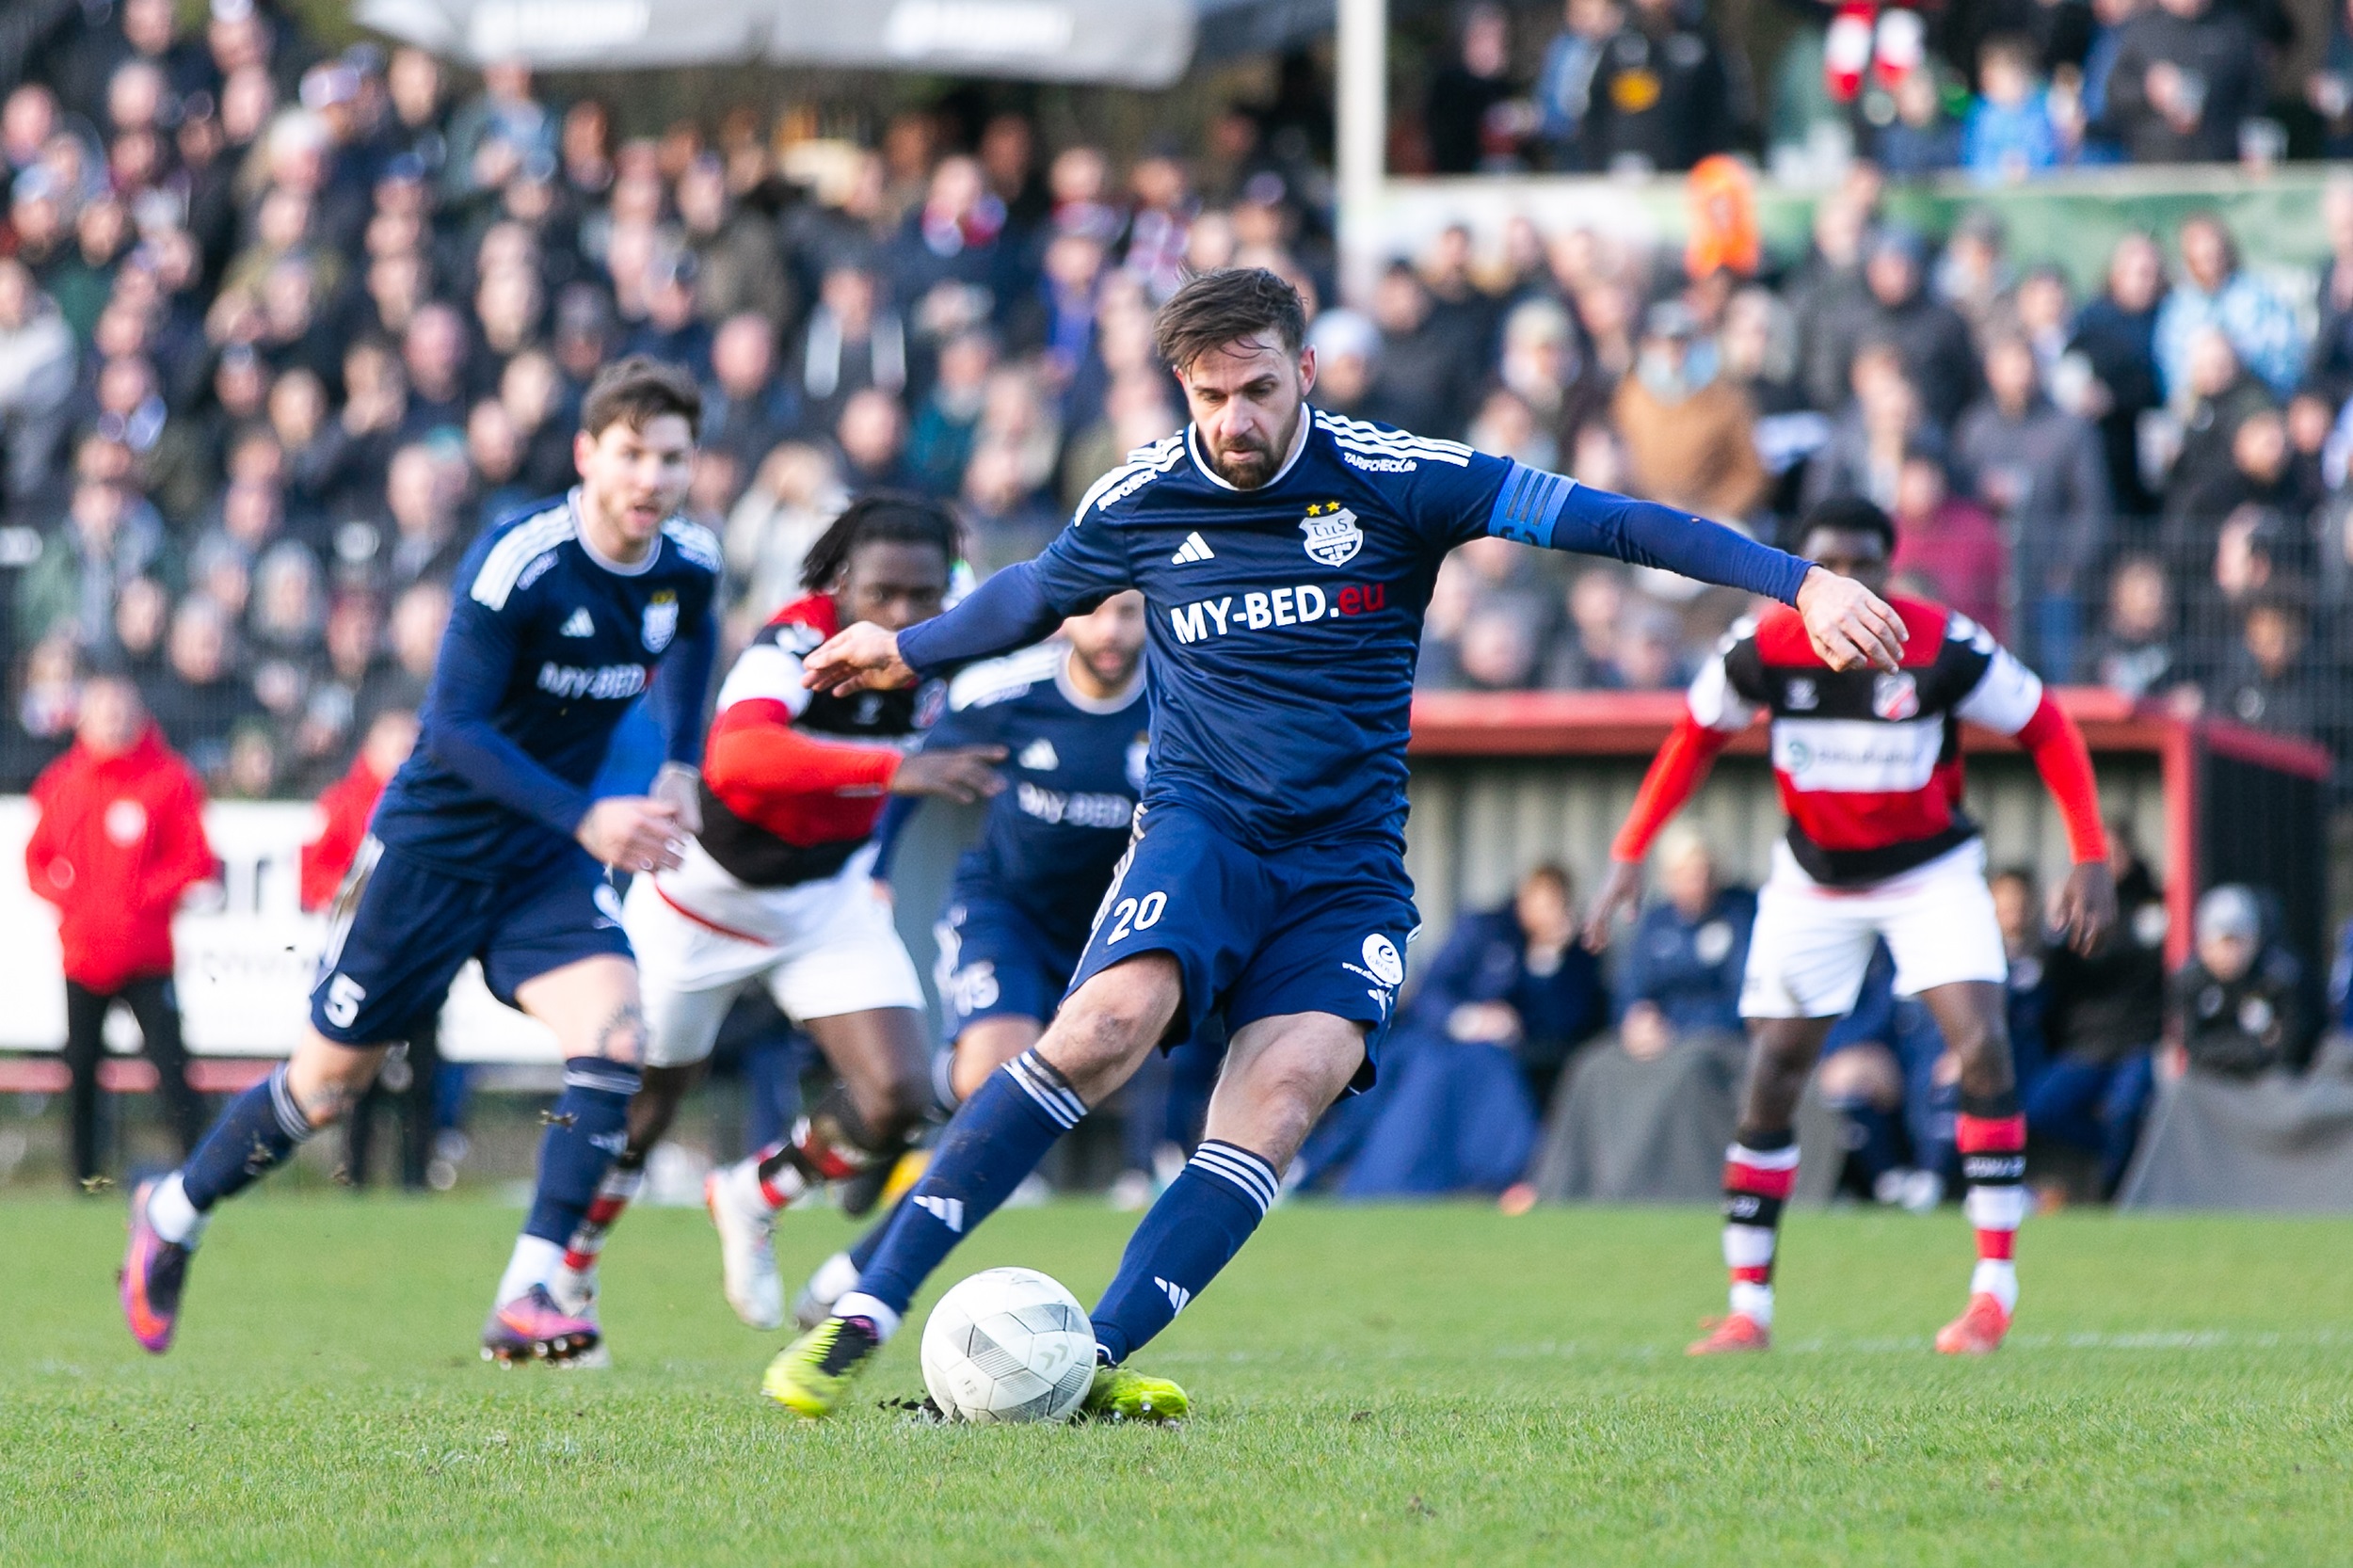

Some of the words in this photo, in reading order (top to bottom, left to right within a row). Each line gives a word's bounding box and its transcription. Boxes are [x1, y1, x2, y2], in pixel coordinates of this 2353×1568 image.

[1170, 583, 1385, 645] MY-BED.eu
[1107, 890, 1168, 946] 20
[323, 971, 367, 1029] 5
